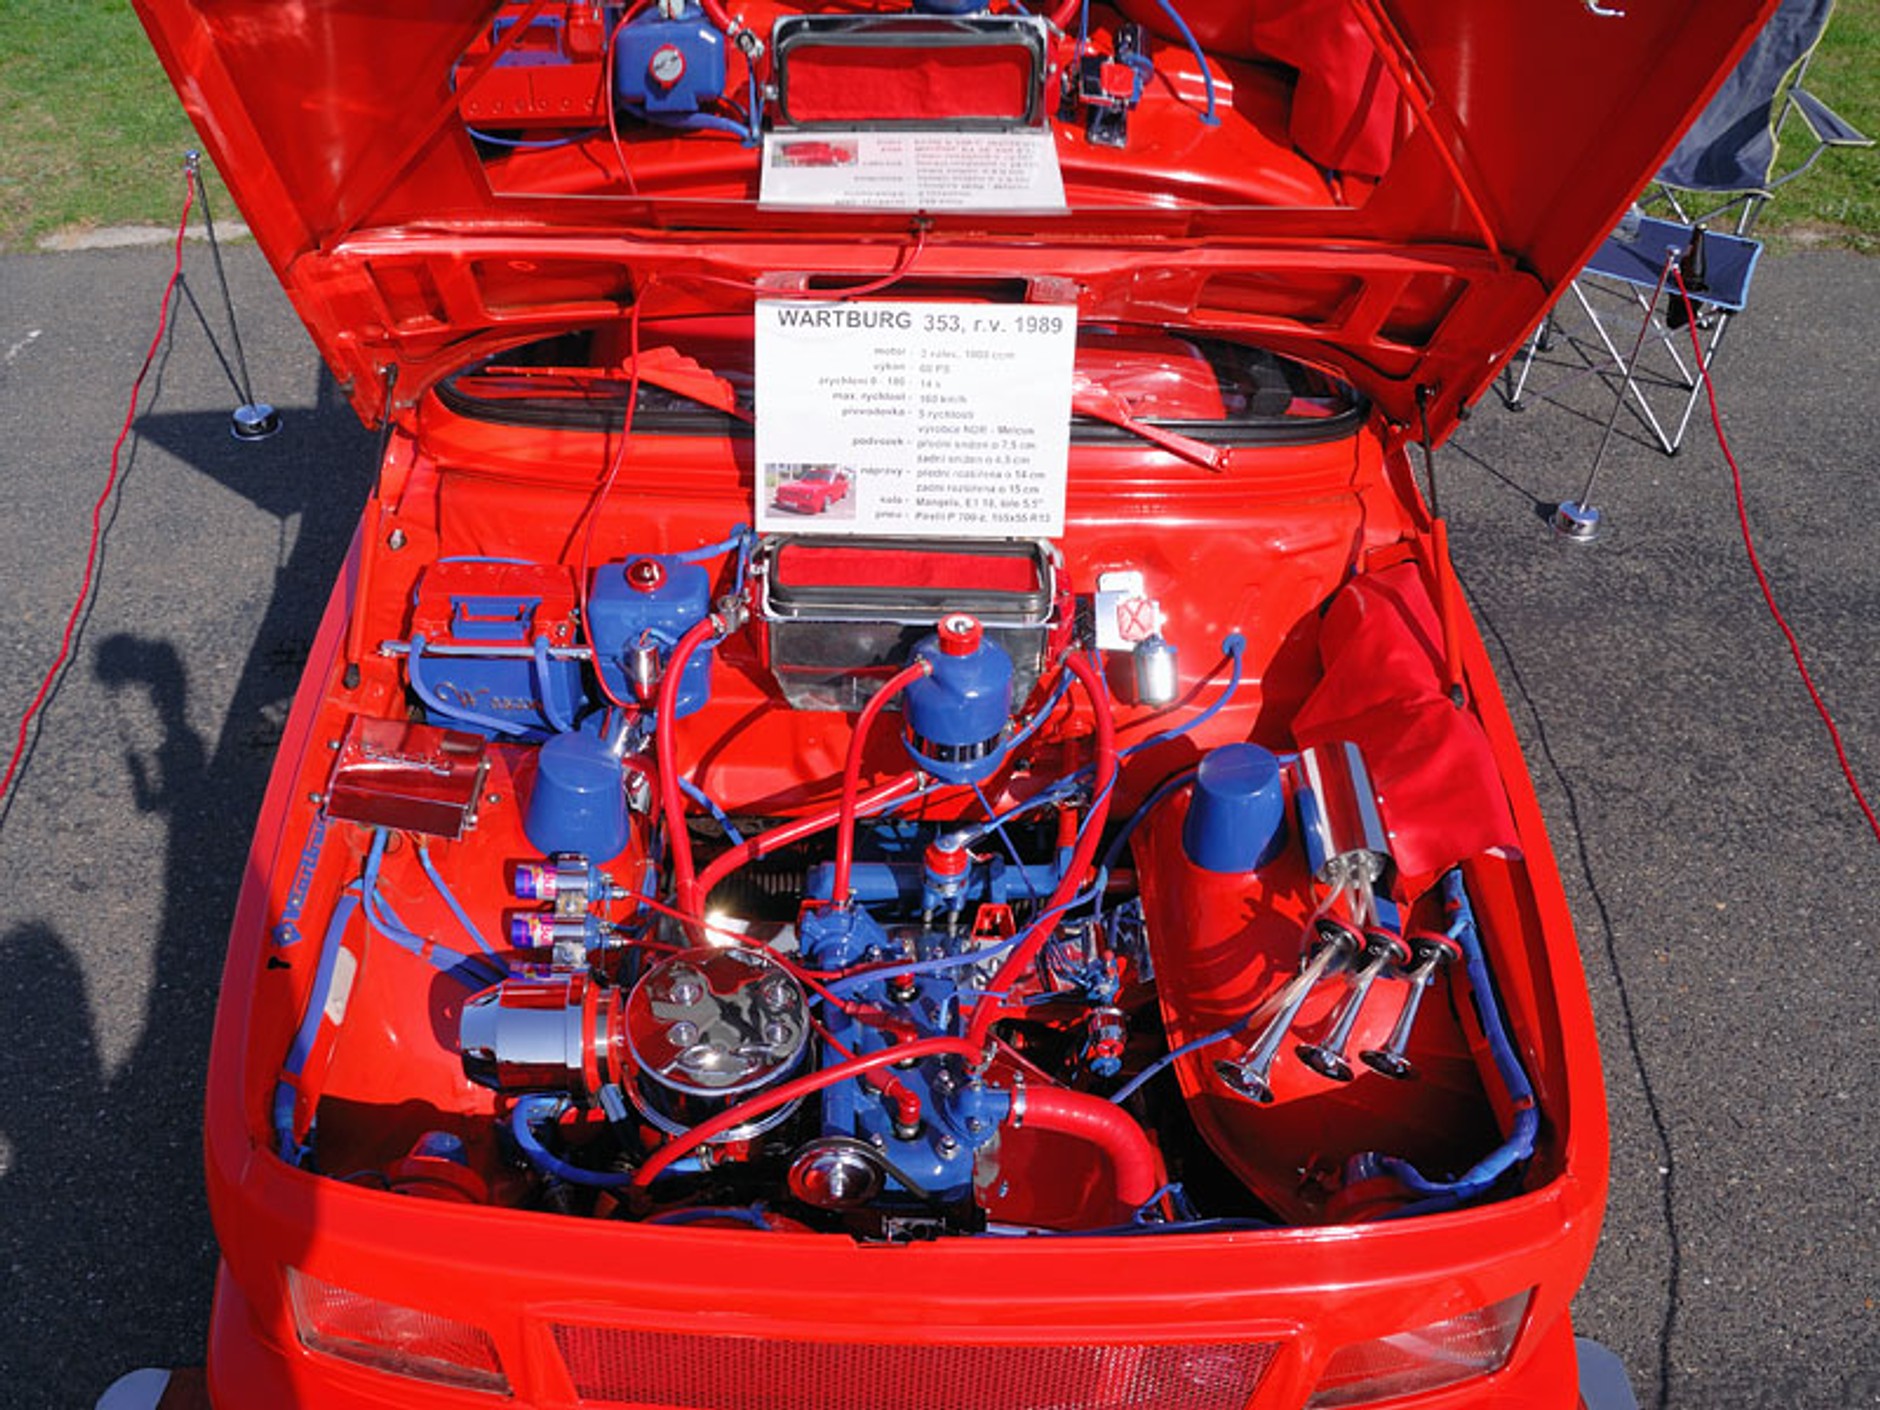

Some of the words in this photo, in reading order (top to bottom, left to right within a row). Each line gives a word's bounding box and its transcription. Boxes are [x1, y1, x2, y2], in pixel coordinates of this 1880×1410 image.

[778, 309, 912, 329] WARTBURG
[923, 315, 965, 334] 353,
[973, 318, 1006, 333] r.v.
[1015, 316, 1063, 333] 1989
[920, 379, 932, 388] 14
